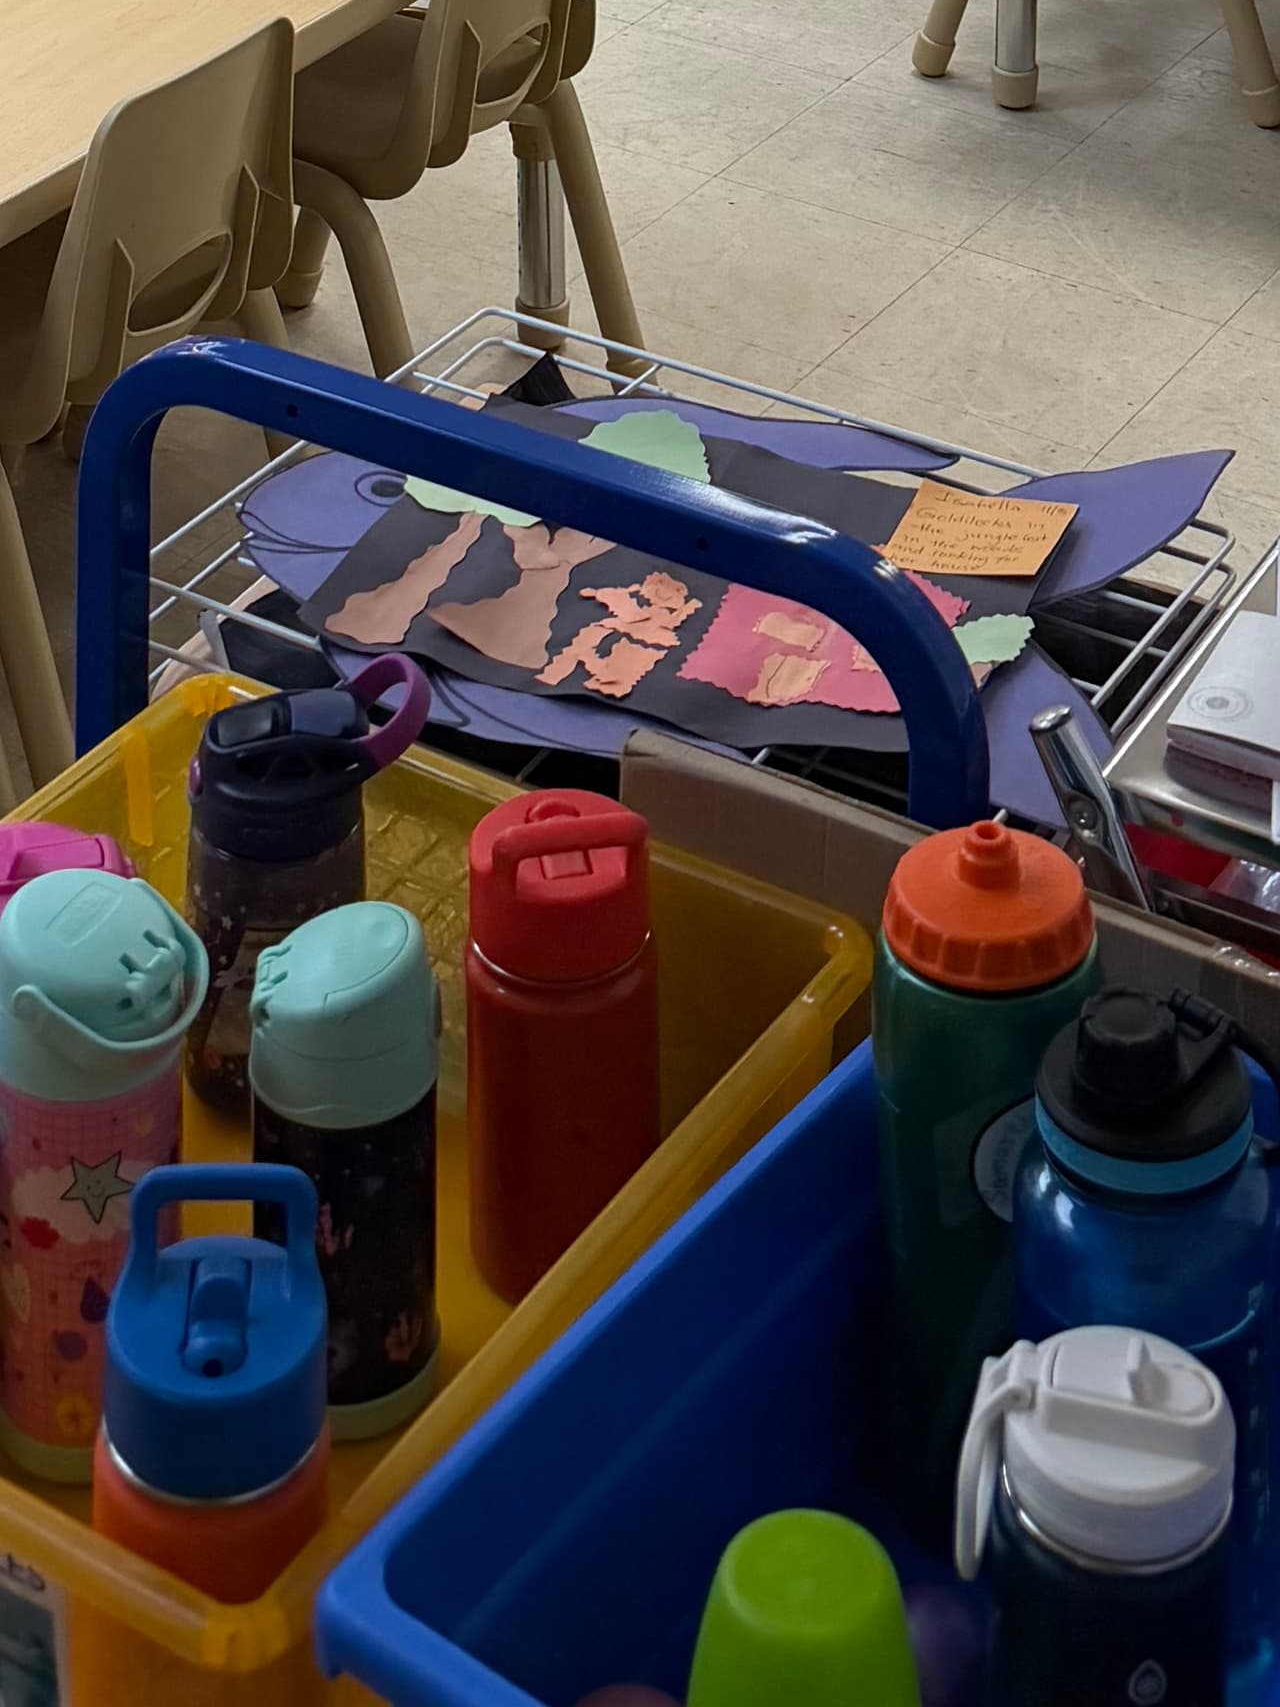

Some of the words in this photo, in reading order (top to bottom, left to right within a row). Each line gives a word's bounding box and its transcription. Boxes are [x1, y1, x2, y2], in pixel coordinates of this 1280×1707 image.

[936, 491, 1021, 512] Isabella
[916, 507, 1012, 529] Goldilocks
[912, 522, 944, 535] the
[891, 542, 924, 555] and
[933, 540, 955, 549] the
